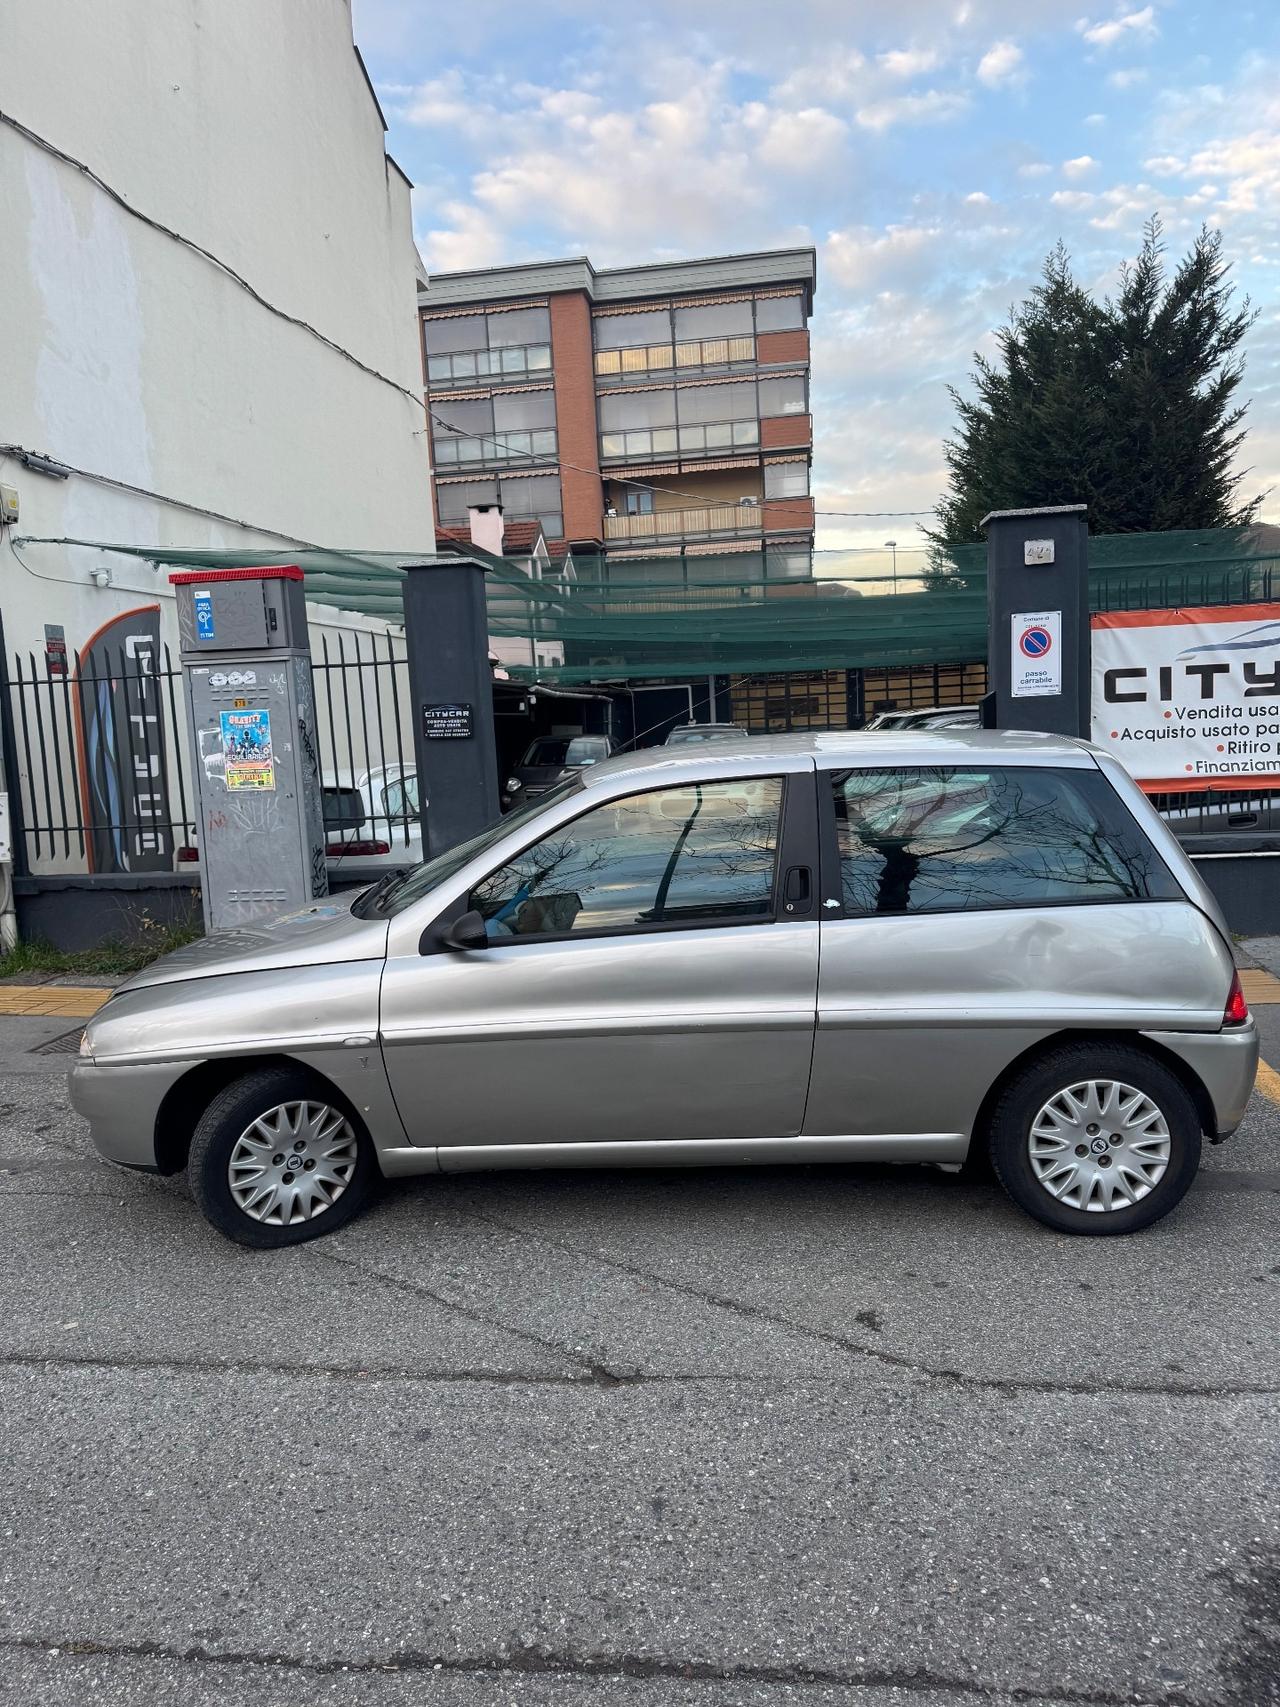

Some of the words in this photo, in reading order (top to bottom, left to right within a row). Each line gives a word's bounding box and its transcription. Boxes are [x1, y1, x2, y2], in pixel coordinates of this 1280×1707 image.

[1025, 670, 1048, 678] passo
[1020, 677, 1053, 685] carrabile
[1104, 661, 1280, 703] CITY
[1174, 706, 1243, 720] Vendita
[1248, 705, 1280, 717] usa
[1120, 726, 1196, 742] Acquisto
[1202, 723, 1250, 737] usato
[1227, 741, 1271, 754] Ritiro
[1196, 760, 1280, 773] Finanziam
